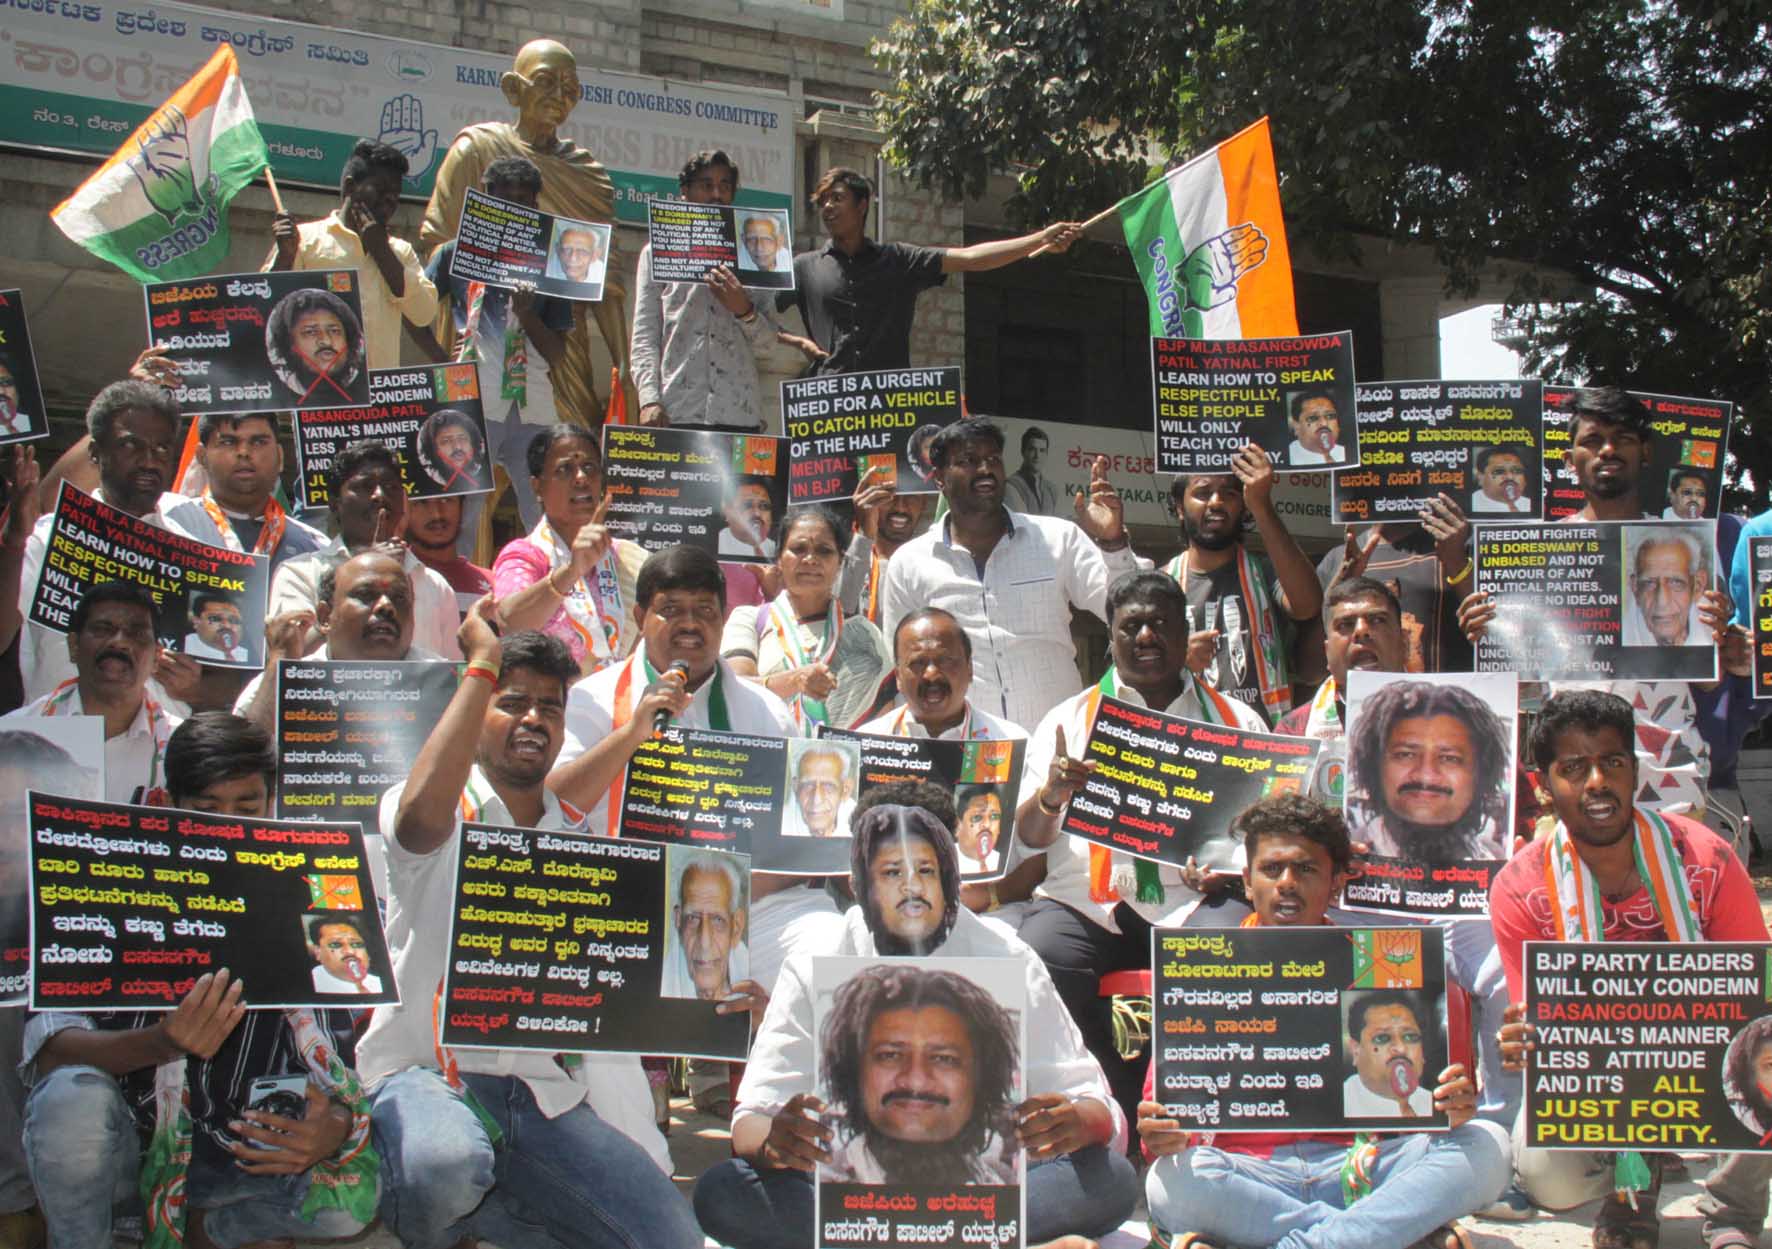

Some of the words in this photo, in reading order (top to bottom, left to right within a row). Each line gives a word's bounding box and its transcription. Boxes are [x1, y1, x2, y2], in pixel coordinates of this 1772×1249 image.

[618, 89, 692, 116] CONGRESS
[695, 102, 778, 128] COMMITTEE
[651, 203, 688, 211] FREEDOM
[689, 205, 720, 214] FIGHTER
[1158, 339, 1185, 351] BJP
[1190, 341, 1222, 353] MLA
[1226, 336, 1341, 353] BASANGOWDA
[1159, 355, 1198, 368] PATIL
[1203, 357, 1260, 368] YATNAL
[1265, 355, 1310, 368] FIRST
[786, 380, 838, 398] THERE
[843, 378, 857, 391] IS
[861, 377, 872, 390] A
[876, 372, 944, 389] URGENT
[1159, 372, 1209, 385] LEARN
[1214, 373, 1250, 386] HOW
[1256, 373, 1276, 385] TO
[1280, 368, 1335, 384] SPEAK
[1160, 388, 1280, 402] RESPECTFULLY,
[788, 400, 829, 418] NEED
[834, 396, 866, 412] FOR
[870, 395, 882, 409] A
[885, 391, 956, 408] VEHICLE
[1161, 404, 1198, 417] ELSE
[1203, 405, 1264, 417] PEOPLE
[301, 408, 389, 423] BASANGOUDA
[392, 405, 428, 417] PATIL
[303, 426, 360, 439] YATNAL'S
[364, 420, 419, 436] MANNER
[789, 423, 809, 437] TO
[814, 416, 866, 434] CATCH
[870, 413, 916, 428] HOLD
[1161, 420, 1196, 433] WILL
[1201, 421, 1242, 433] ONLY
[305, 442, 335, 454] LESS
[790, 442, 810, 458] OF
[814, 438, 845, 453] THE
[849, 433, 891, 450] HALF
[1161, 436, 1213, 449] TEACH
[1217, 437, 1250, 449] YOU
[307, 459, 332, 470] AND
[792, 457, 854, 476] MENTAL
[1161, 453, 1191, 465] THE
[793, 483, 808, 496] IN
[812, 479, 843, 494] BJP.
[64, 486, 93, 509] BJP
[97, 505, 128, 528] MLA
[134, 518, 256, 567] BASANGOWDA
[1480, 530, 1539, 541] FREEDOM
[1543, 529, 1596, 539] FIGHTER
[61, 503, 99, 534] PATIL
[106, 527, 166, 560] YATNAL
[171, 552, 220, 573] FIRST
[58, 519, 110, 553] LEARN
[113, 543, 154, 569] HOW
[158, 562, 181, 577] TO
[186, 571, 245, 592] SPEAK
[1480, 545, 1488, 554] H
[1492, 544, 1500, 553] S
[1503, 542, 1585, 553] DORESWAMY
[1587, 542, 1598, 551] IS
[50, 551, 89, 580] ELSE
[53, 535, 183, 595] RESPECTFULLY,
[1483, 556, 1545, 567] UNBIASED
[1549, 556, 1575, 565] AND
[1579, 555, 1604, 565] NOT
[45, 568, 84, 596] WILL
[1480, 570, 1491, 580] IN
[1495, 569, 1544, 579] FAVOUR
[1548, 570, 1565, 578] OF
[1568, 569, 1594, 578] ANY
[1480, 583, 1544, 593] POLITICAL
[1545, 596, 1563, 605] NO
[1567, 595, 1597, 605] IDEA
[1600, 595, 1617, 604] ON
[37, 602, 71, 626] THE
[1596, 635, 1613, 644] AN
[1536, 952, 1576, 971] BJP
[1582, 953, 1650, 971] PARTY
[1656, 953, 1754, 971] LEADERS
[1535, 978, 1587, 996] WILL
[1592, 978, 1647, 996] ONLY
[1653, 977, 1759, 996] CONDEMN
[1537, 1002, 1687, 1021] BASANGOUDA
[1692, 1002, 1748, 1020] PATIL
[1536, 1026, 1634, 1044] YATNAL'S
[1640, 1026, 1731, 1044] MANNER
[1536, 1051, 1590, 1068] LESS
[1605, 1051, 1706, 1068] ATTITUDE
[1536, 1075, 1580, 1093] AND
[1586, 1075, 1624, 1093] IT'S
[1653, 1076, 1705, 1093] ALL
[1536, 1100, 1620, 1118] JUST
[1630, 1100, 1700, 1118] FOR
[1536, 1124, 1717, 1143] PUBLICITY.
